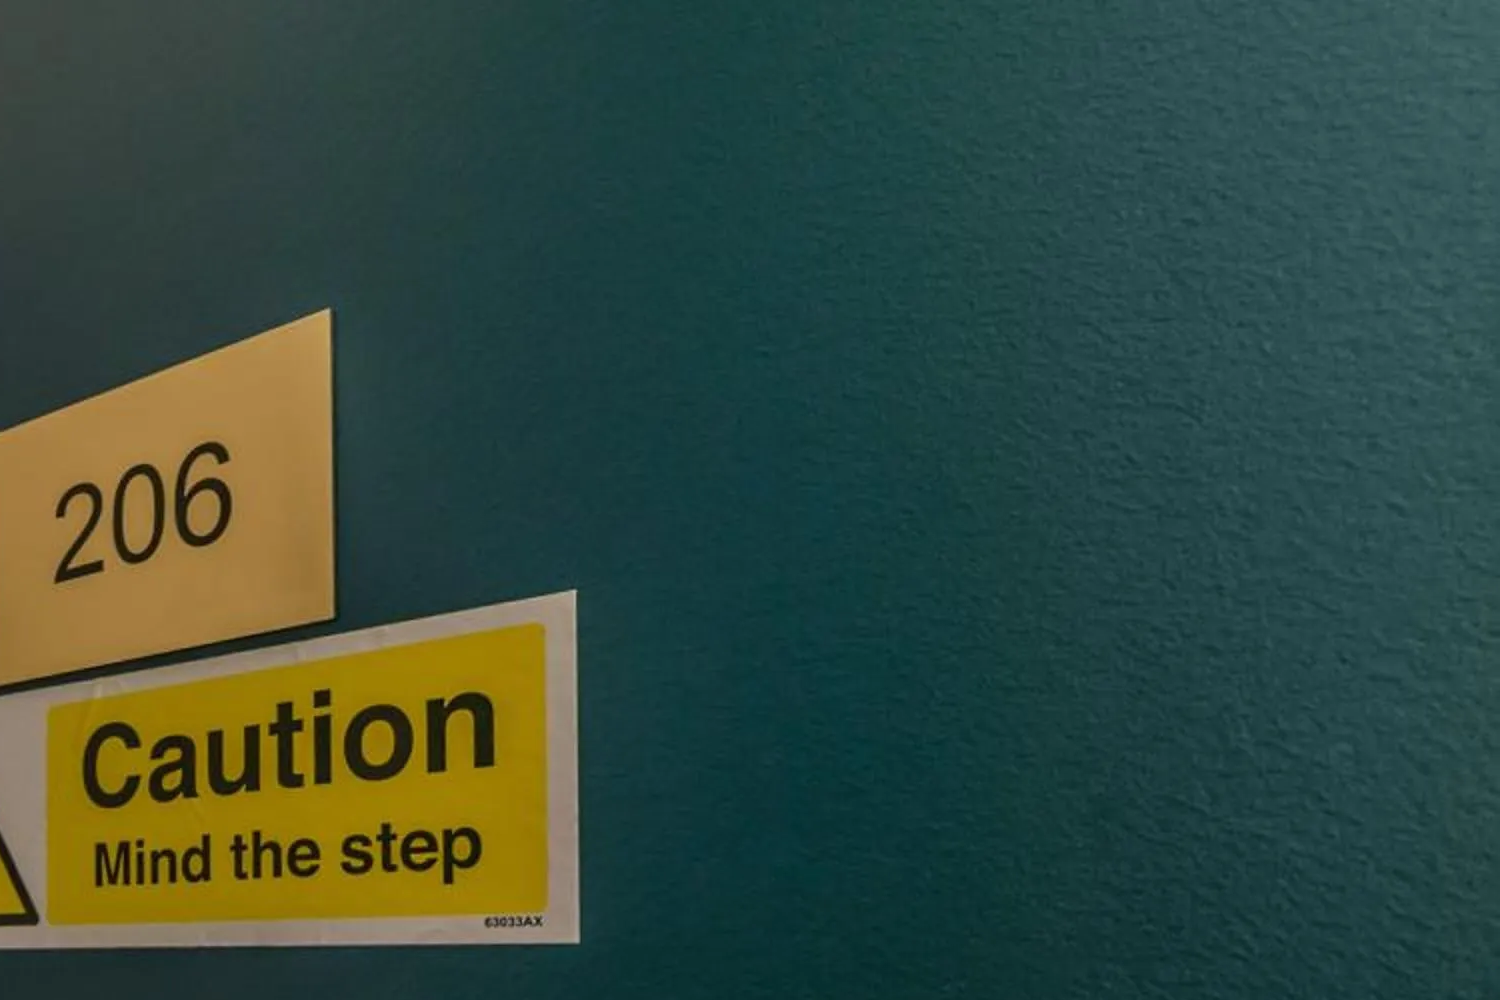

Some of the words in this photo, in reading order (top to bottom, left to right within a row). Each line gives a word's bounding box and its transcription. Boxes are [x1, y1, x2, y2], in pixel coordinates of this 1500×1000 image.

[53, 441, 233, 585] 206
[81, 687, 496, 810] Caution
[94, 832, 212, 889] Mind
[228, 829, 322, 881] the
[339, 821, 483, 886] step
